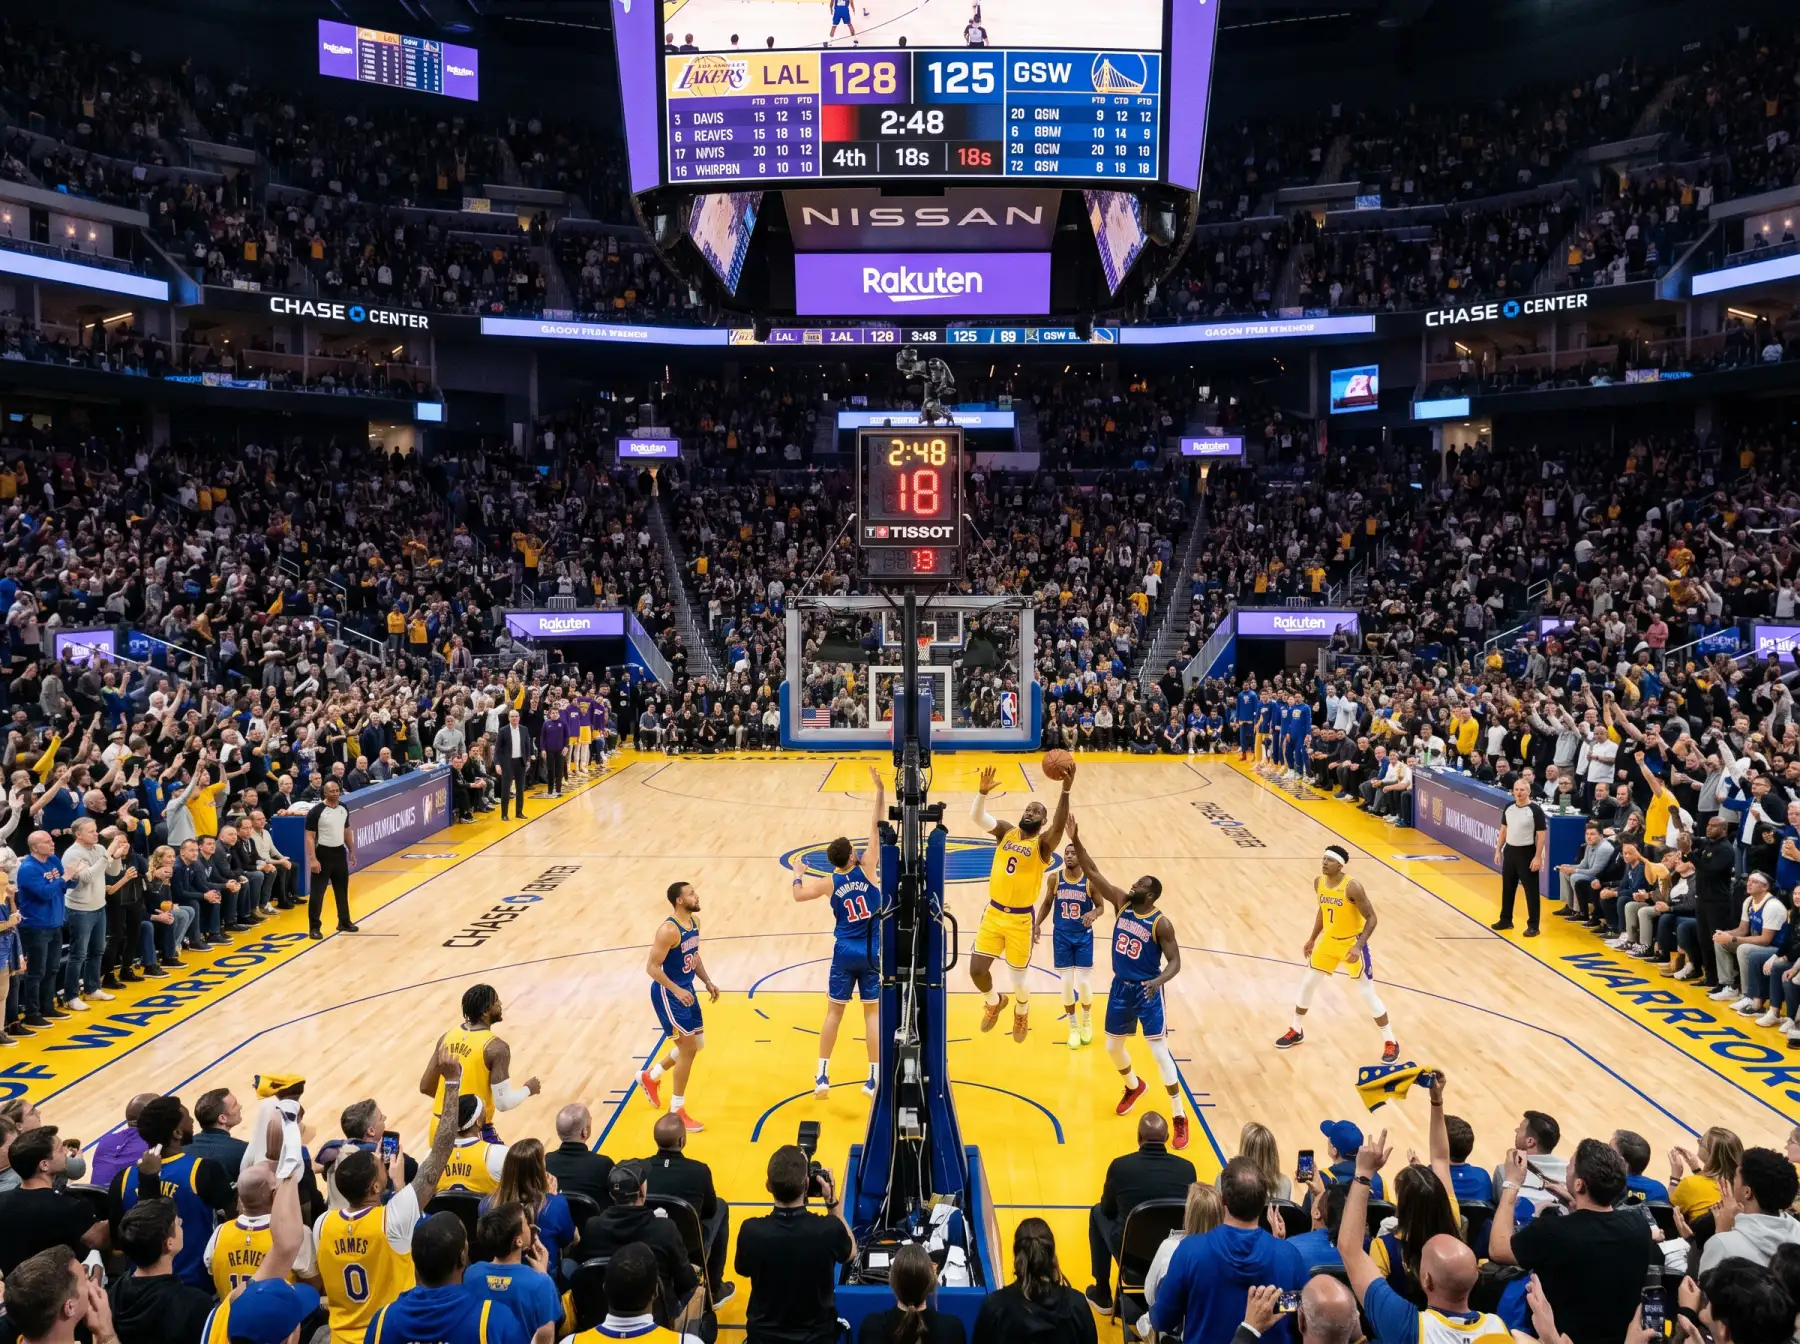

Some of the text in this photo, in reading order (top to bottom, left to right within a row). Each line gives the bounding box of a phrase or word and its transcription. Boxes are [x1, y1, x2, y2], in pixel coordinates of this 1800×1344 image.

[678, 64, 745, 89] LAKERS
[763, 64, 809, 85] LAL
[828, 62, 897, 96] 128
[927, 60, 995, 94] 125
[1013, 62, 1072, 84] GSW
[674, 110, 812, 125] 3 DAVIS 15 12 15
[880, 110, 944, 136] 2:48
[1011, 108, 1025, 119] 20
[1096, 110, 1104, 121] 9
[1116, 111, 1128, 122] 12
[1140, 112, 1151, 122] 12
[675, 127, 812, 142] 6 REAVES 15 18 18
[1011, 126, 1018, 137] 6
[1093, 128, 1104, 138] 10
[1115, 128, 1126, 138] 14
[1144, 128, 1150, 139] 9
[675, 149, 686, 159] 17
[776, 145, 788, 156] 10
[801, 144, 812, 155] 12
[832, 146, 992, 168] 4th 18s 18s
[1092, 145, 1104, 155] 20
[676, 166, 687, 177] 16
[759, 163, 766, 173] 8
[777, 162, 788, 173] 10
[801, 162, 812, 172] 10
[803, 206, 1042, 228] NISSAN
[862, 266, 983, 295] Rakuten
[270, 296, 429, 329] CHASE CENTER
[1425, 293, 1588, 326] CHASE CENTER
[830, 332, 854, 342] LAL
[870, 332, 894, 342] 128
[911, 330, 938, 342] 3:48
[953, 331, 977, 342] 125
[1044, 332, 1066, 340] GSW
[888, 439, 946, 466] 2:48
[900, 470, 938, 514] 18
[890, 527, 954, 538] TISSOT
[540, 617, 591, 630] Rakuten
[1273, 616, 1326, 629] Rakuten
[1006, 856, 1018, 876] 6
[844, 895, 872, 922] 11
[442, 905, 530, 948] CHASE
[1116, 933, 1142, 960] 23
[42, 931, 309, 1052] WARRIORS
[334, 1238, 369, 1255] JAMES
[343, 1262, 370, 1303] 0
